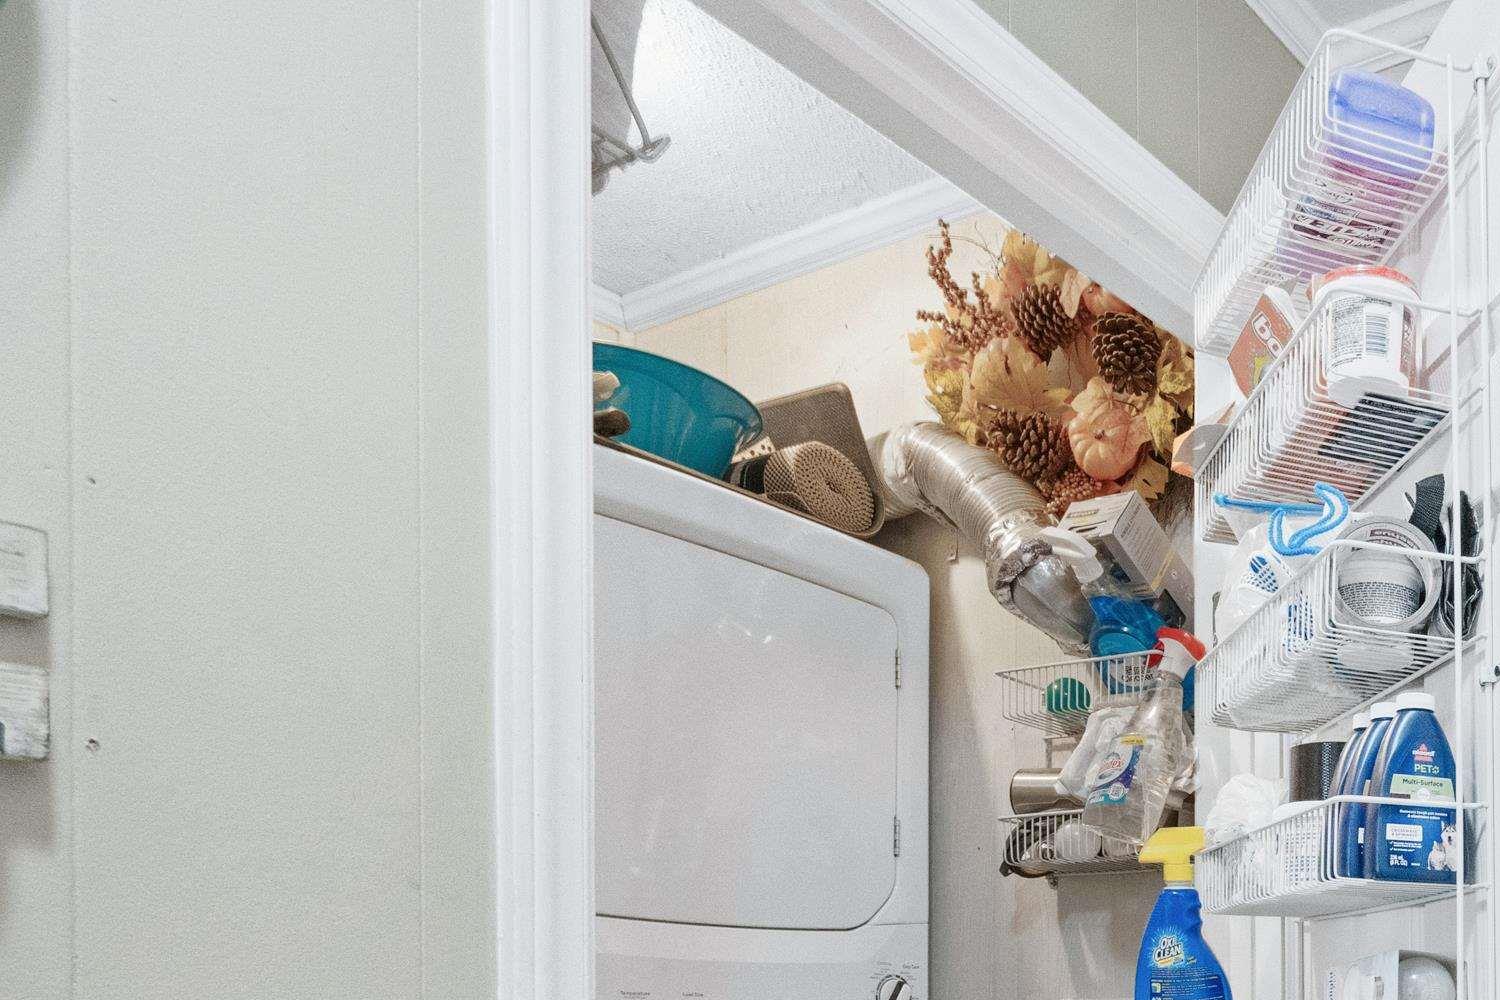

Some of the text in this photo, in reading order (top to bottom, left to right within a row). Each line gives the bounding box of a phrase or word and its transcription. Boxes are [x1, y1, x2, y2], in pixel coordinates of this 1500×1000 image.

[1414, 763, 1433, 774] PET
[1402, 778, 1444, 788] Multi-Surface
[1154, 943, 1182, 961] CLEAN
